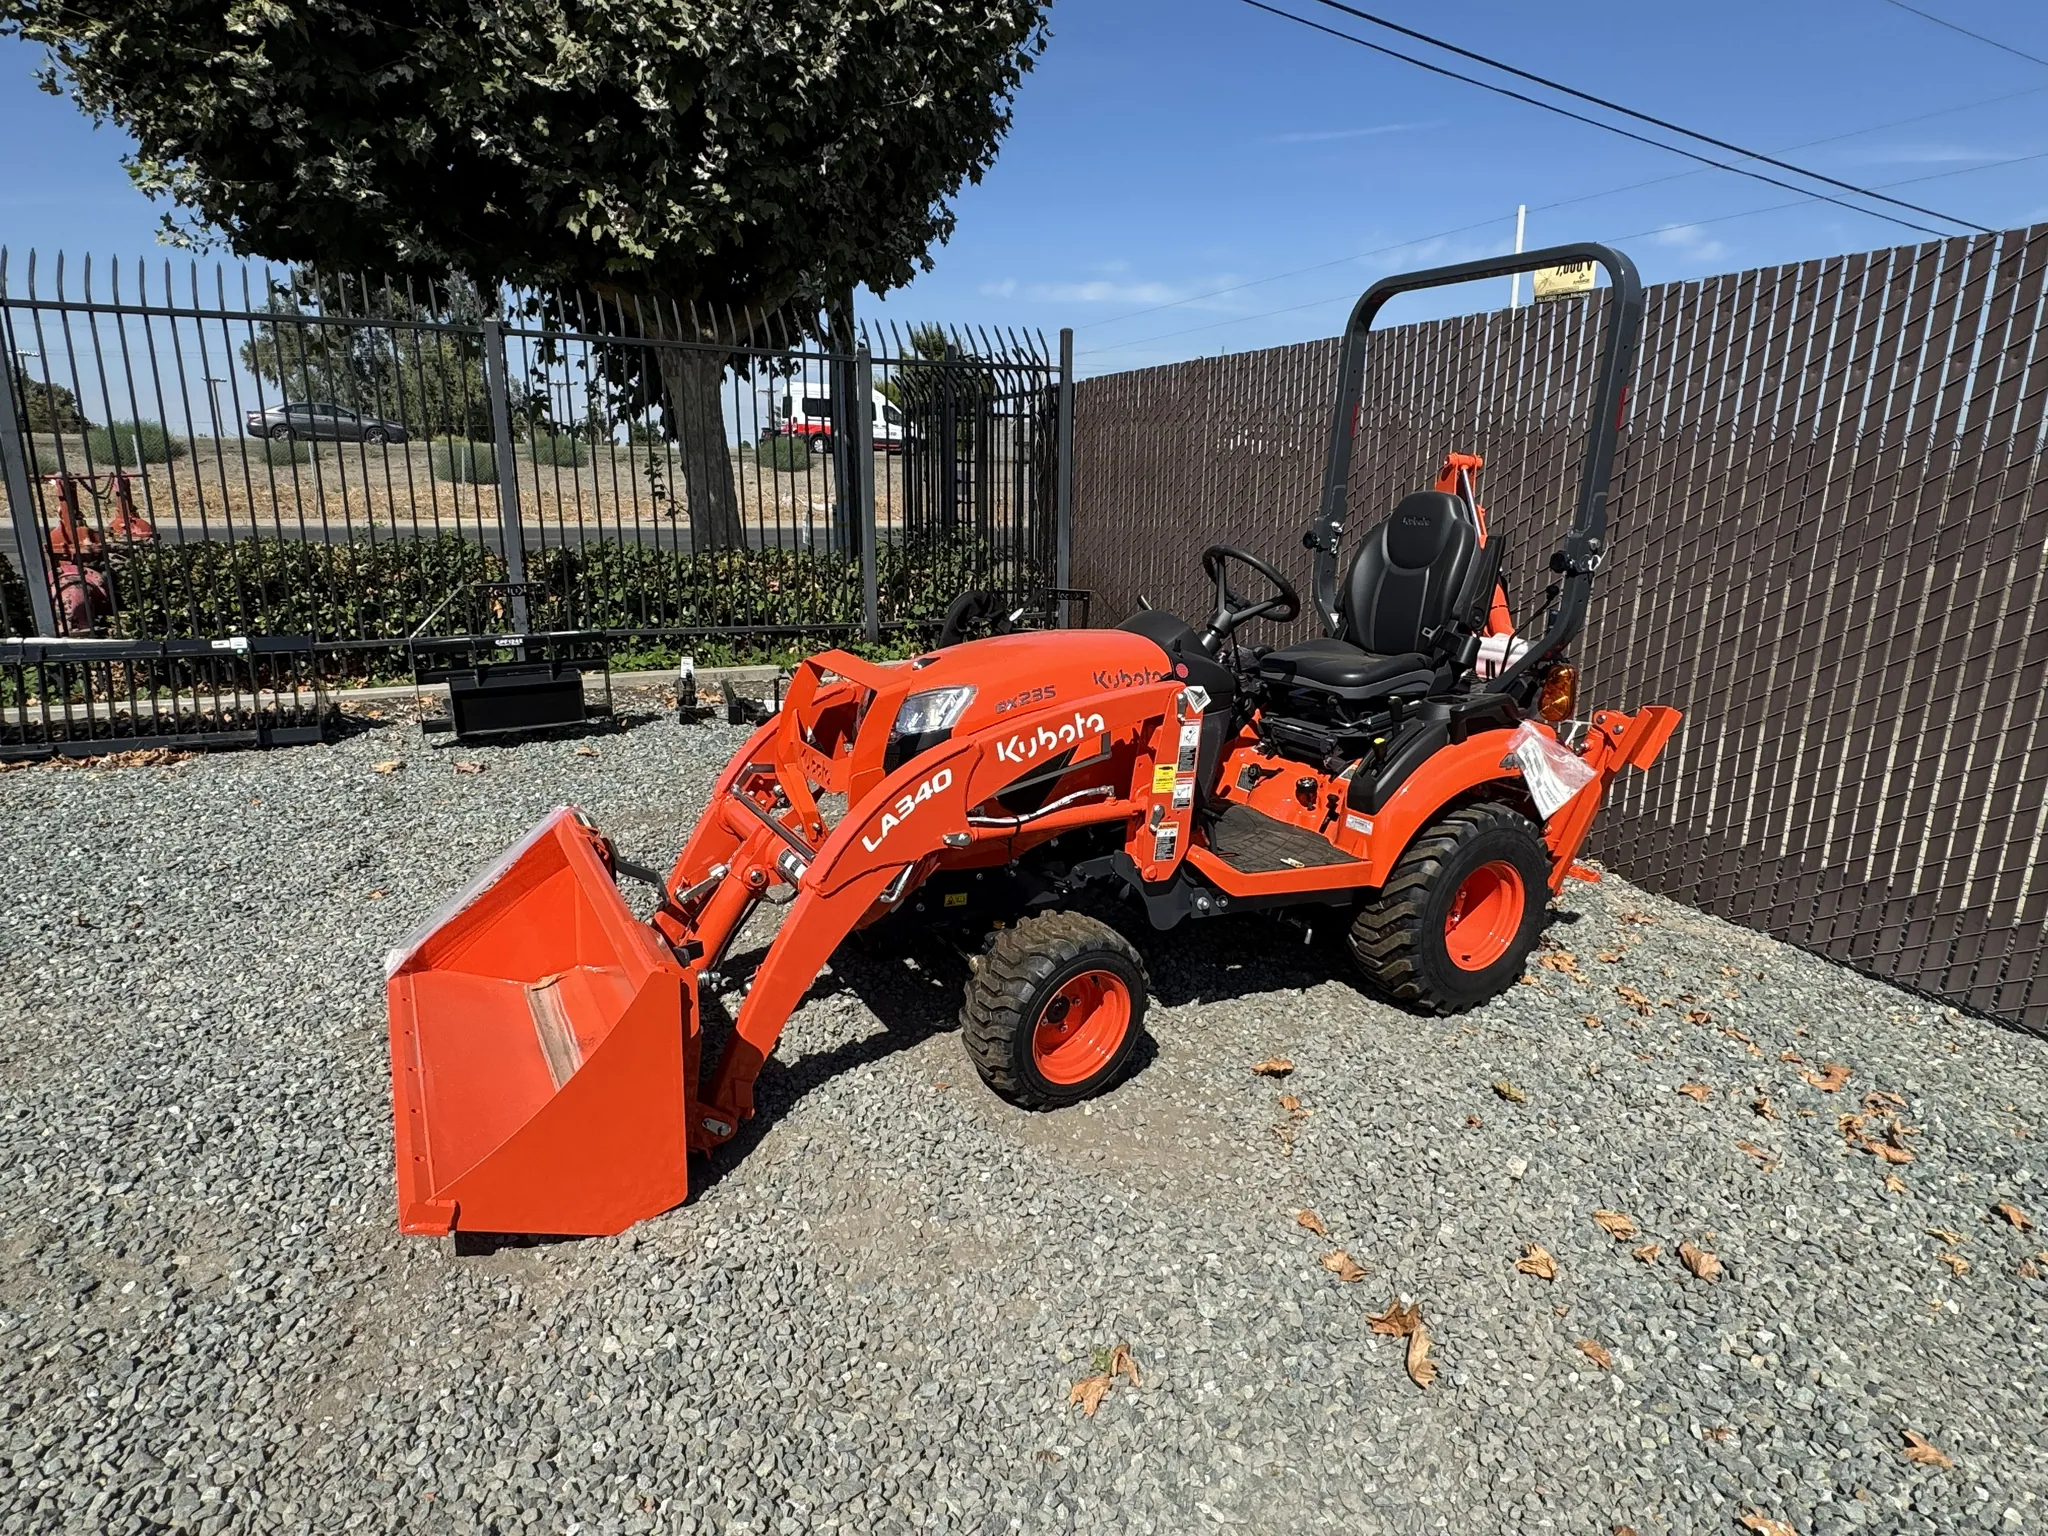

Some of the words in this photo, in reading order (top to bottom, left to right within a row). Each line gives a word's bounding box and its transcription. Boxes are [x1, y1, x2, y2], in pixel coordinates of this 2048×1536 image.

[1092, 666, 1162, 690] Kubota
[996, 712, 1105, 763] Kubota
[861, 768, 952, 853] LA340
